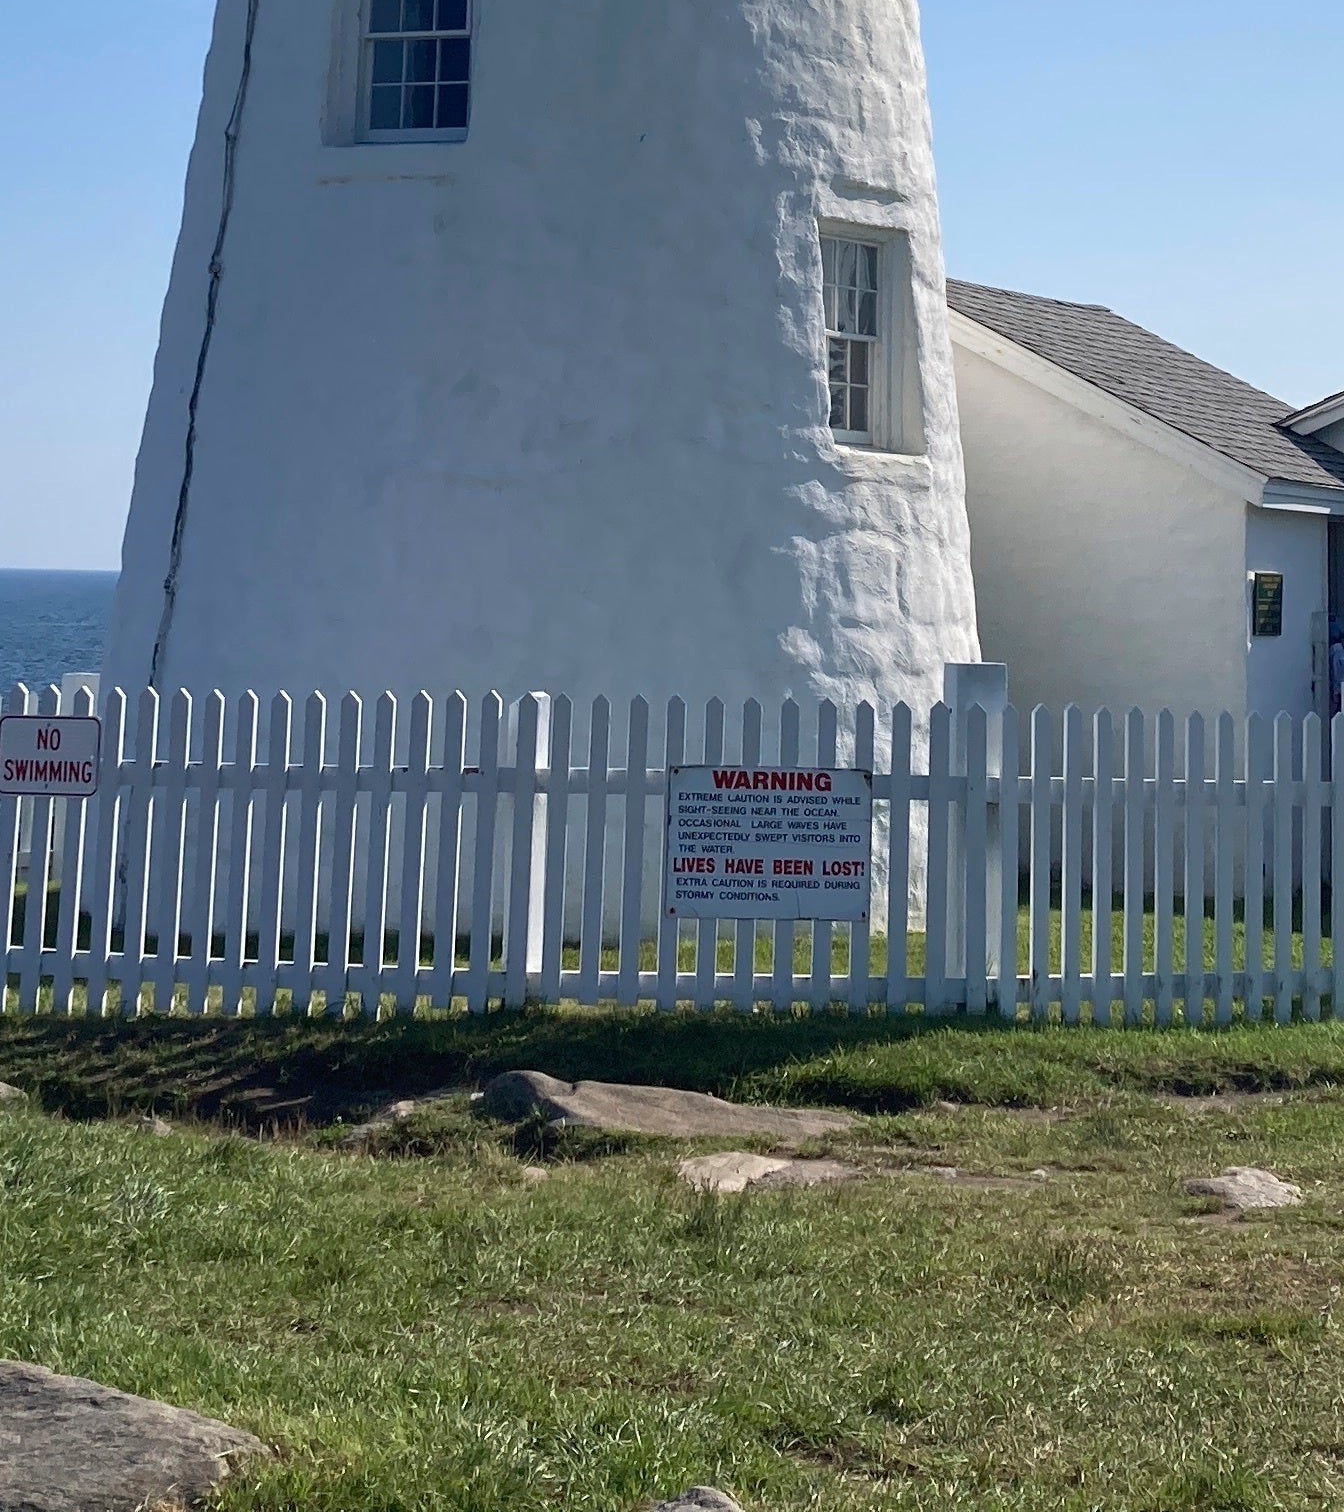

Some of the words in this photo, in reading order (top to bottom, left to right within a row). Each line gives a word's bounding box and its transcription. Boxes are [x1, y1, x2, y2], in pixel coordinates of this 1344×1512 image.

[37, 729, 60, 750] NO
[4, 759, 92, 783] SWIMMING
[713, 770, 832, 791] WARNING
[679, 793, 723, 802] EXTREME
[728, 794, 769, 803] CAUTION
[773, 795, 782, 803] IS
[787, 796, 827, 805] ADVISED
[831, 796, 861, 805] WHILE
[678, 805, 747, 815] SIGHT-SEEING
[751, 807, 776, 815] NEAR
[781, 808, 799, 816] THE
[804, 808, 840, 817] OCEAN.
[679, 819, 741, 828] OCCASIONAL
[751, 821, 783, 829] LARGE
[788, 821, 819, 829] WAVES
[823, 822, 847, 830] HAVE
[678, 832, 749, 841] UNEXPECTEDLY
[755, 833, 788, 842] SWEPT
[792, 834, 835, 843] VISITORS
[840, 835, 860, 843] INTO
[679, 844, 696, 853] THE
[701, 845, 735, 854] WATER.
[673, 857, 715, 873] LIVES
[725, 859, 764, 874] HAVE
[773, 859, 813, 875] BEEN
[822, 860, 865, 877] LOST!
[676, 878, 708, 887] EXTRA
[712, 879, 753, 888] CAUTION
[758, 880, 766, 888] IS
[772, 880, 820, 889] REQUIRED
[824, 881, 860, 890] DURING
[675, 890, 714, 899] STORMY
[720, 891, 780, 901] CONDITIONS.
